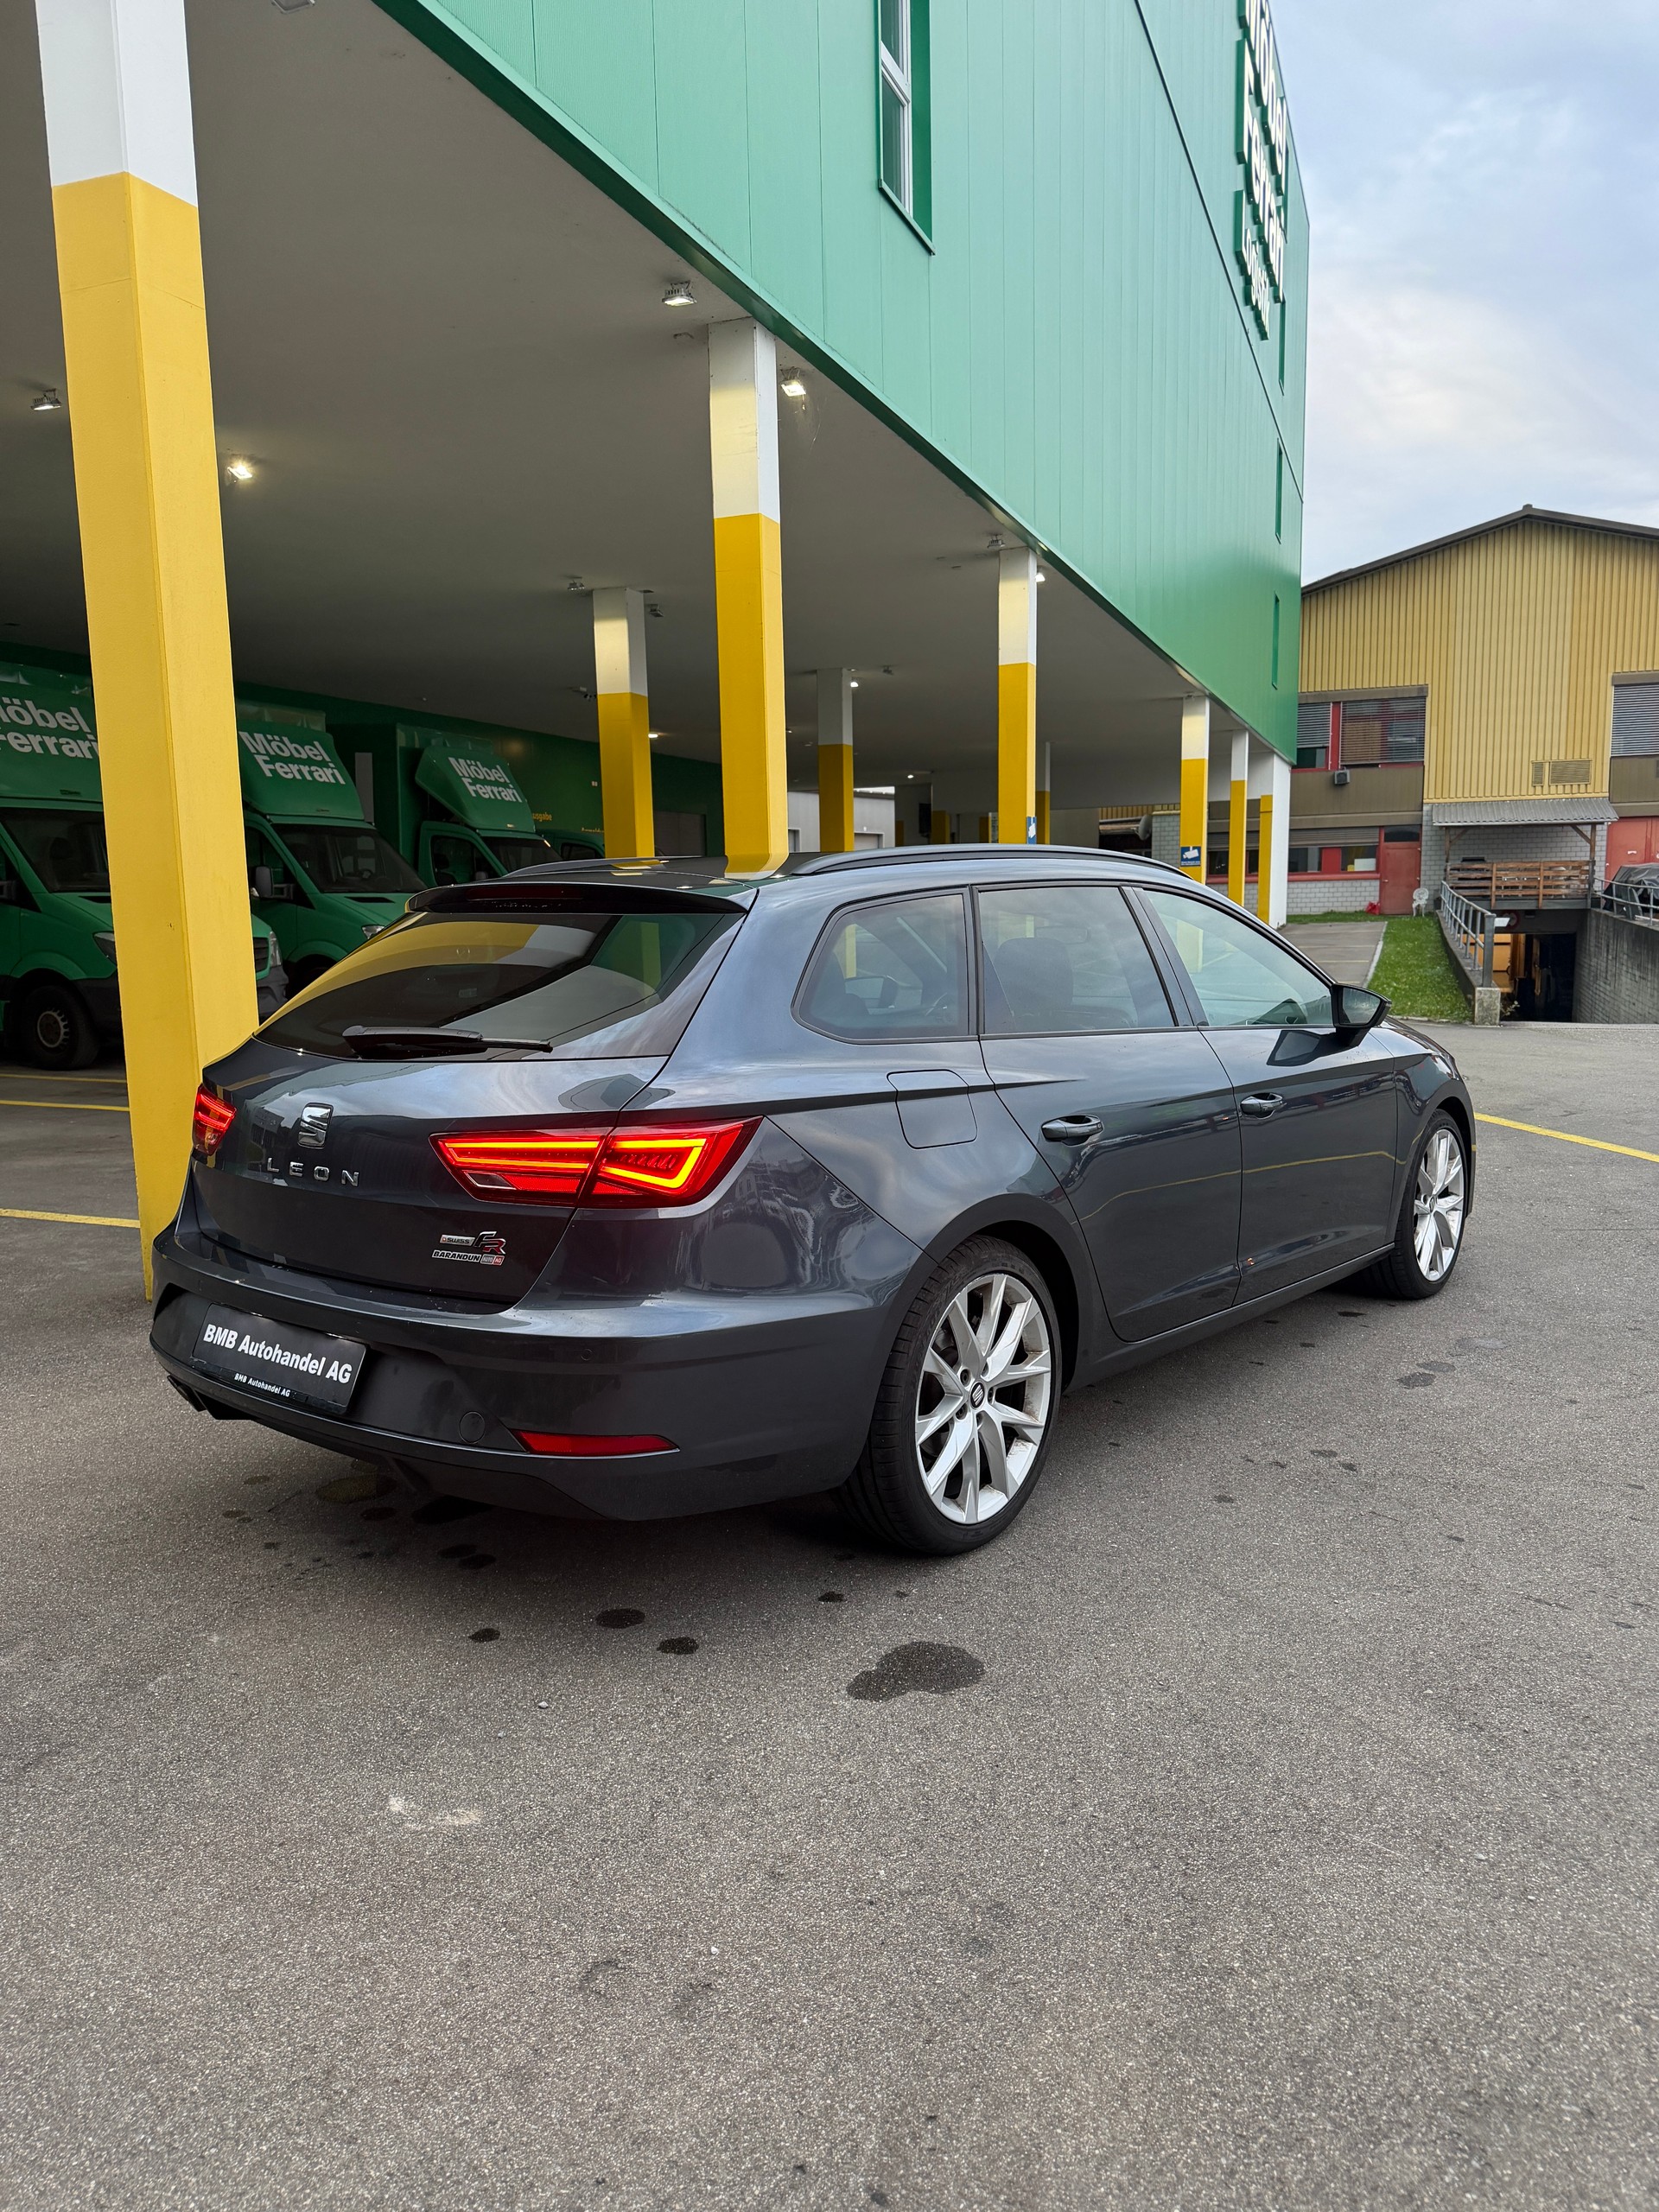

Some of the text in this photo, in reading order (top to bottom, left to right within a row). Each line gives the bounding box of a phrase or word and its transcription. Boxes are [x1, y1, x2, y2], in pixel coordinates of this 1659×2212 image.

[1243, 37, 1284, 303] Ferrari
[0, 696, 92, 733] öbel
[238, 731, 332, 761] Möbel
[254, 754, 346, 785] Ferrari
[448, 757, 511, 783] Möbel
[461, 778, 523, 803] Ferrari
[267, 1157, 359, 1187] LEON
[432, 1249, 481, 1262] BARANDUN
[203, 1324, 353, 1384] BMB Autohandel AG
[234, 1372, 291, 1398] BMB Autohandel AG
